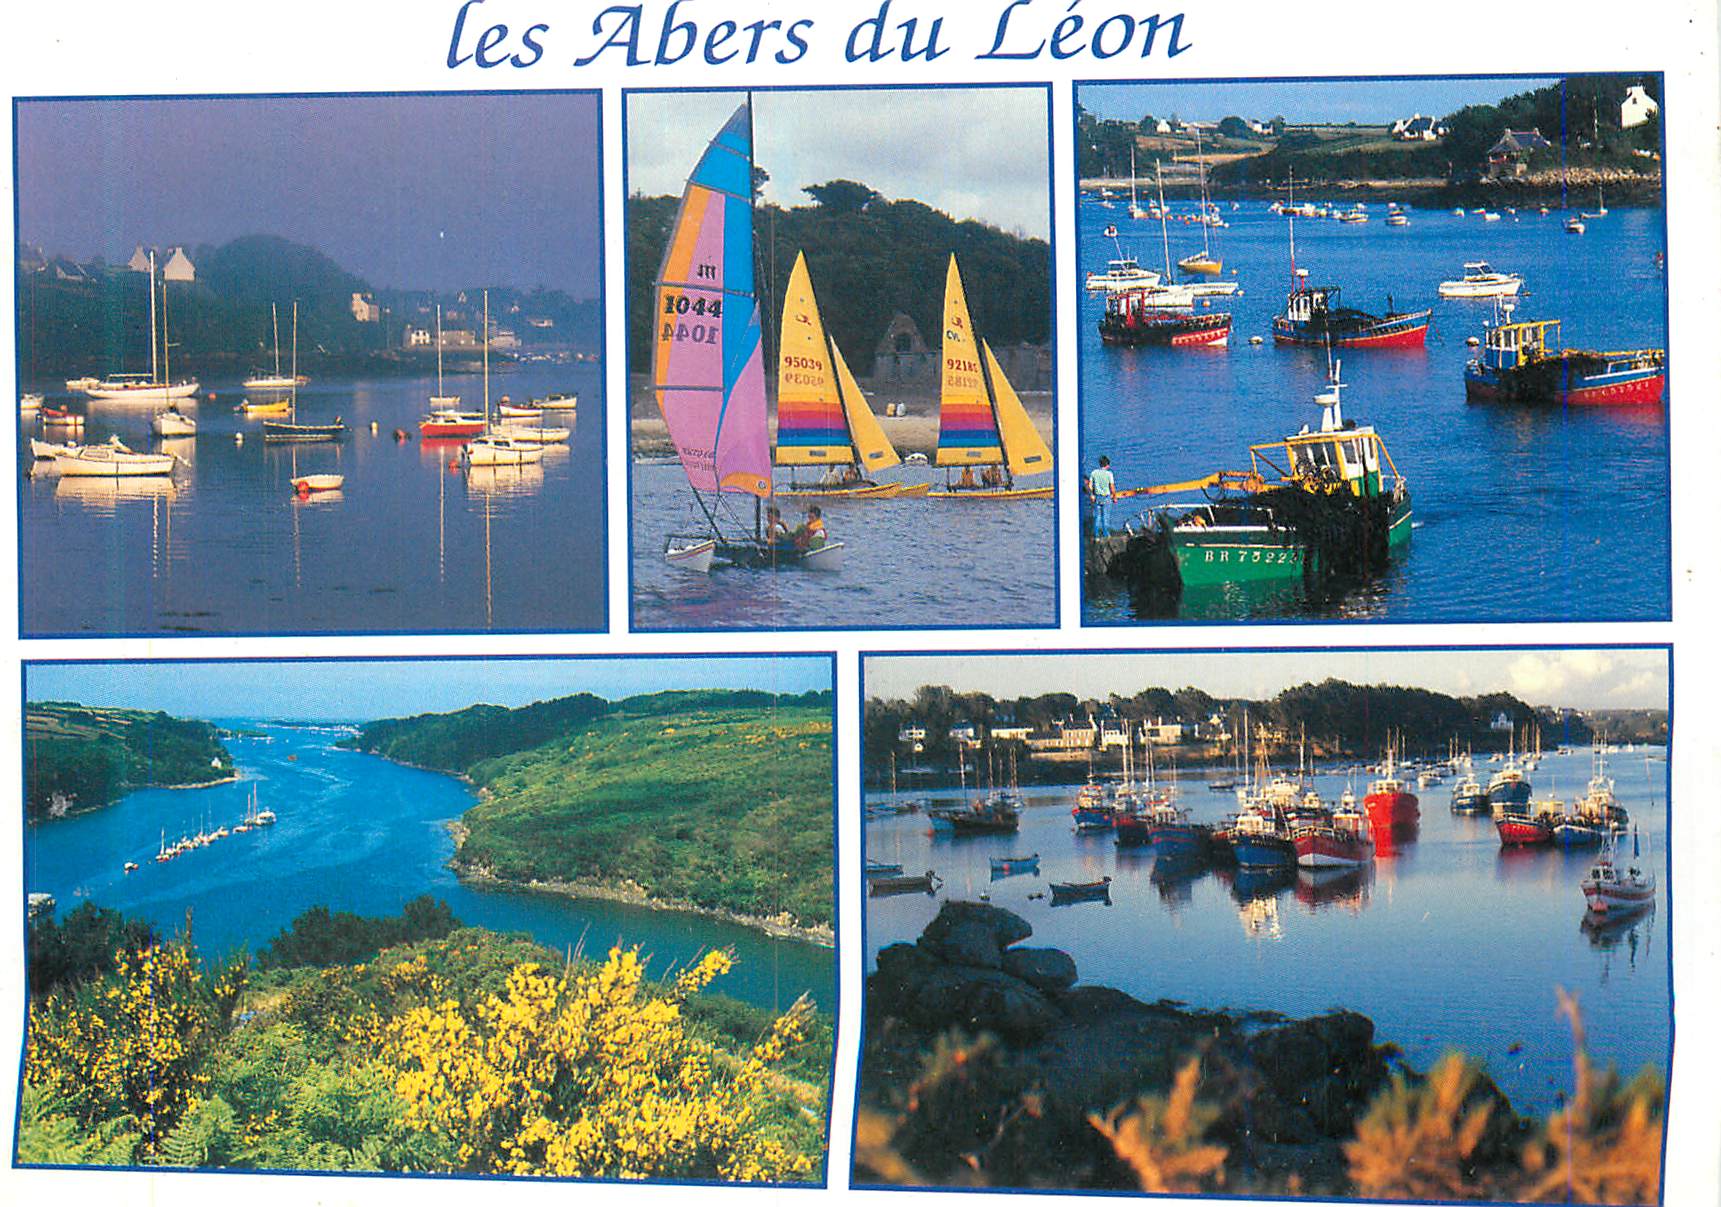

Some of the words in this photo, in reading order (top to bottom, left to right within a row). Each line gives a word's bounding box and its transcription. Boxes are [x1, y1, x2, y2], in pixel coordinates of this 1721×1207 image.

[664, 294, 723, 318] 1044
[784, 355, 823, 371] 95039
[1204, 550, 1229, 562] BR
